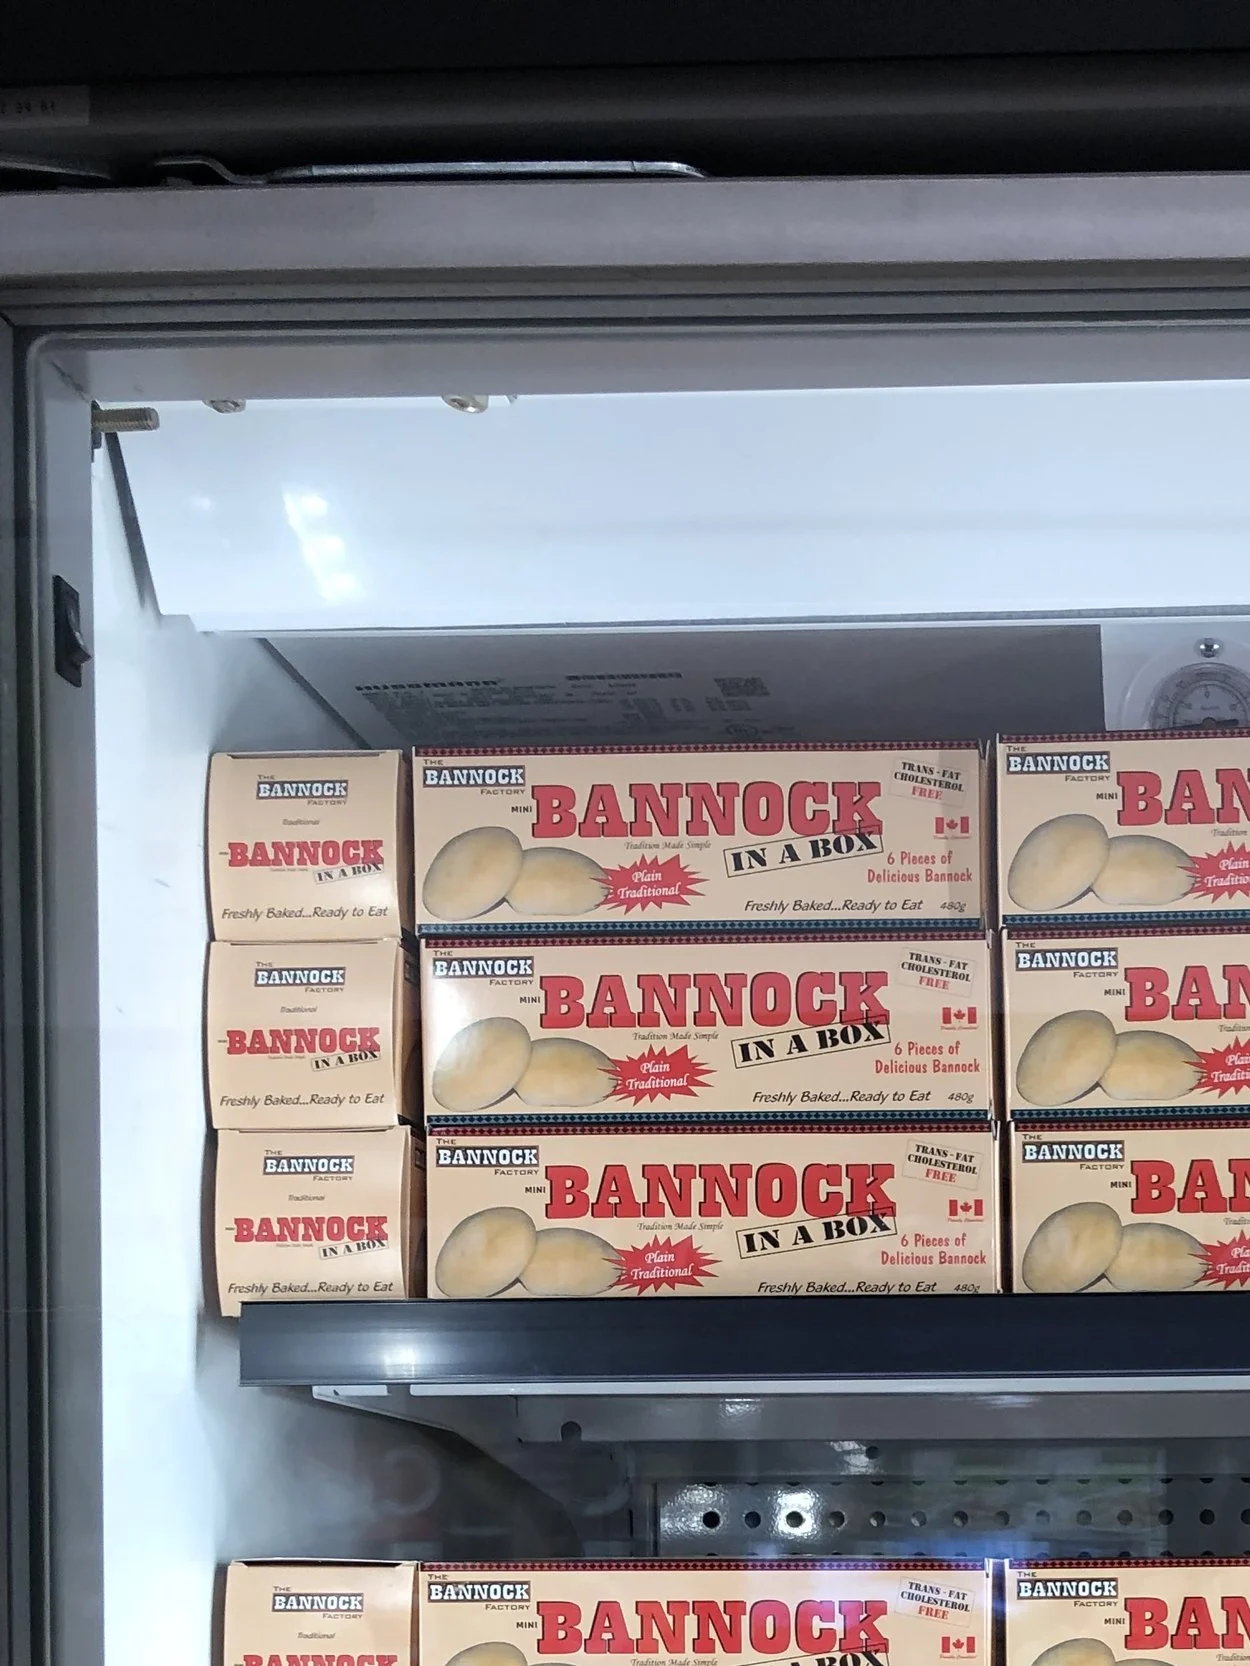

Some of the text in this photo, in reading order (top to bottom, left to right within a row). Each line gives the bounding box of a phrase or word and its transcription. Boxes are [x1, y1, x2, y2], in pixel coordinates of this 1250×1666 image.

[531, 781, 883, 838] BANNOCK
[227, 839, 384, 868] BANNOCK
[434, 959, 534, 976] BANNOCK
[908, 952, 969, 971] TRANS FAT
[900, 962, 971, 983] CHOLESTEROL
[917, 976, 950, 990] FREE
[540, 971, 890, 1029] BANNOCK
[225, 1026, 380, 1056] BANNOCK
[632, 1031, 720, 1043] Tradition Made Simple
[738, 1021, 885, 1063] IN A BOX
[893, 1040, 961, 1055] 6 Pieces of
[639, 1061, 671, 1074] Plain
[874, 1059, 980, 1074] Delicious Bannock
[626, 1075, 689, 1090] Traditional
[753, 1090, 796, 1105] Freshly
[891, 1091, 905, 1102] to
[908, 1090, 931, 1101] Eat
[946, 1092, 974, 1104] 480g
[263, 1158, 353, 1173] BANNOCK
[544, 1163, 897, 1219] BANNOCK
[234, 1215, 388, 1243] BANNOCK
[320, 1240, 386, 1258] IN A BOX
[228, 1282, 269, 1295] Freshly
[357, 1283, 369, 1292] to
[372, 1281, 394, 1292] Eat
[536, 1600, 890, 1654] BANNOCK
